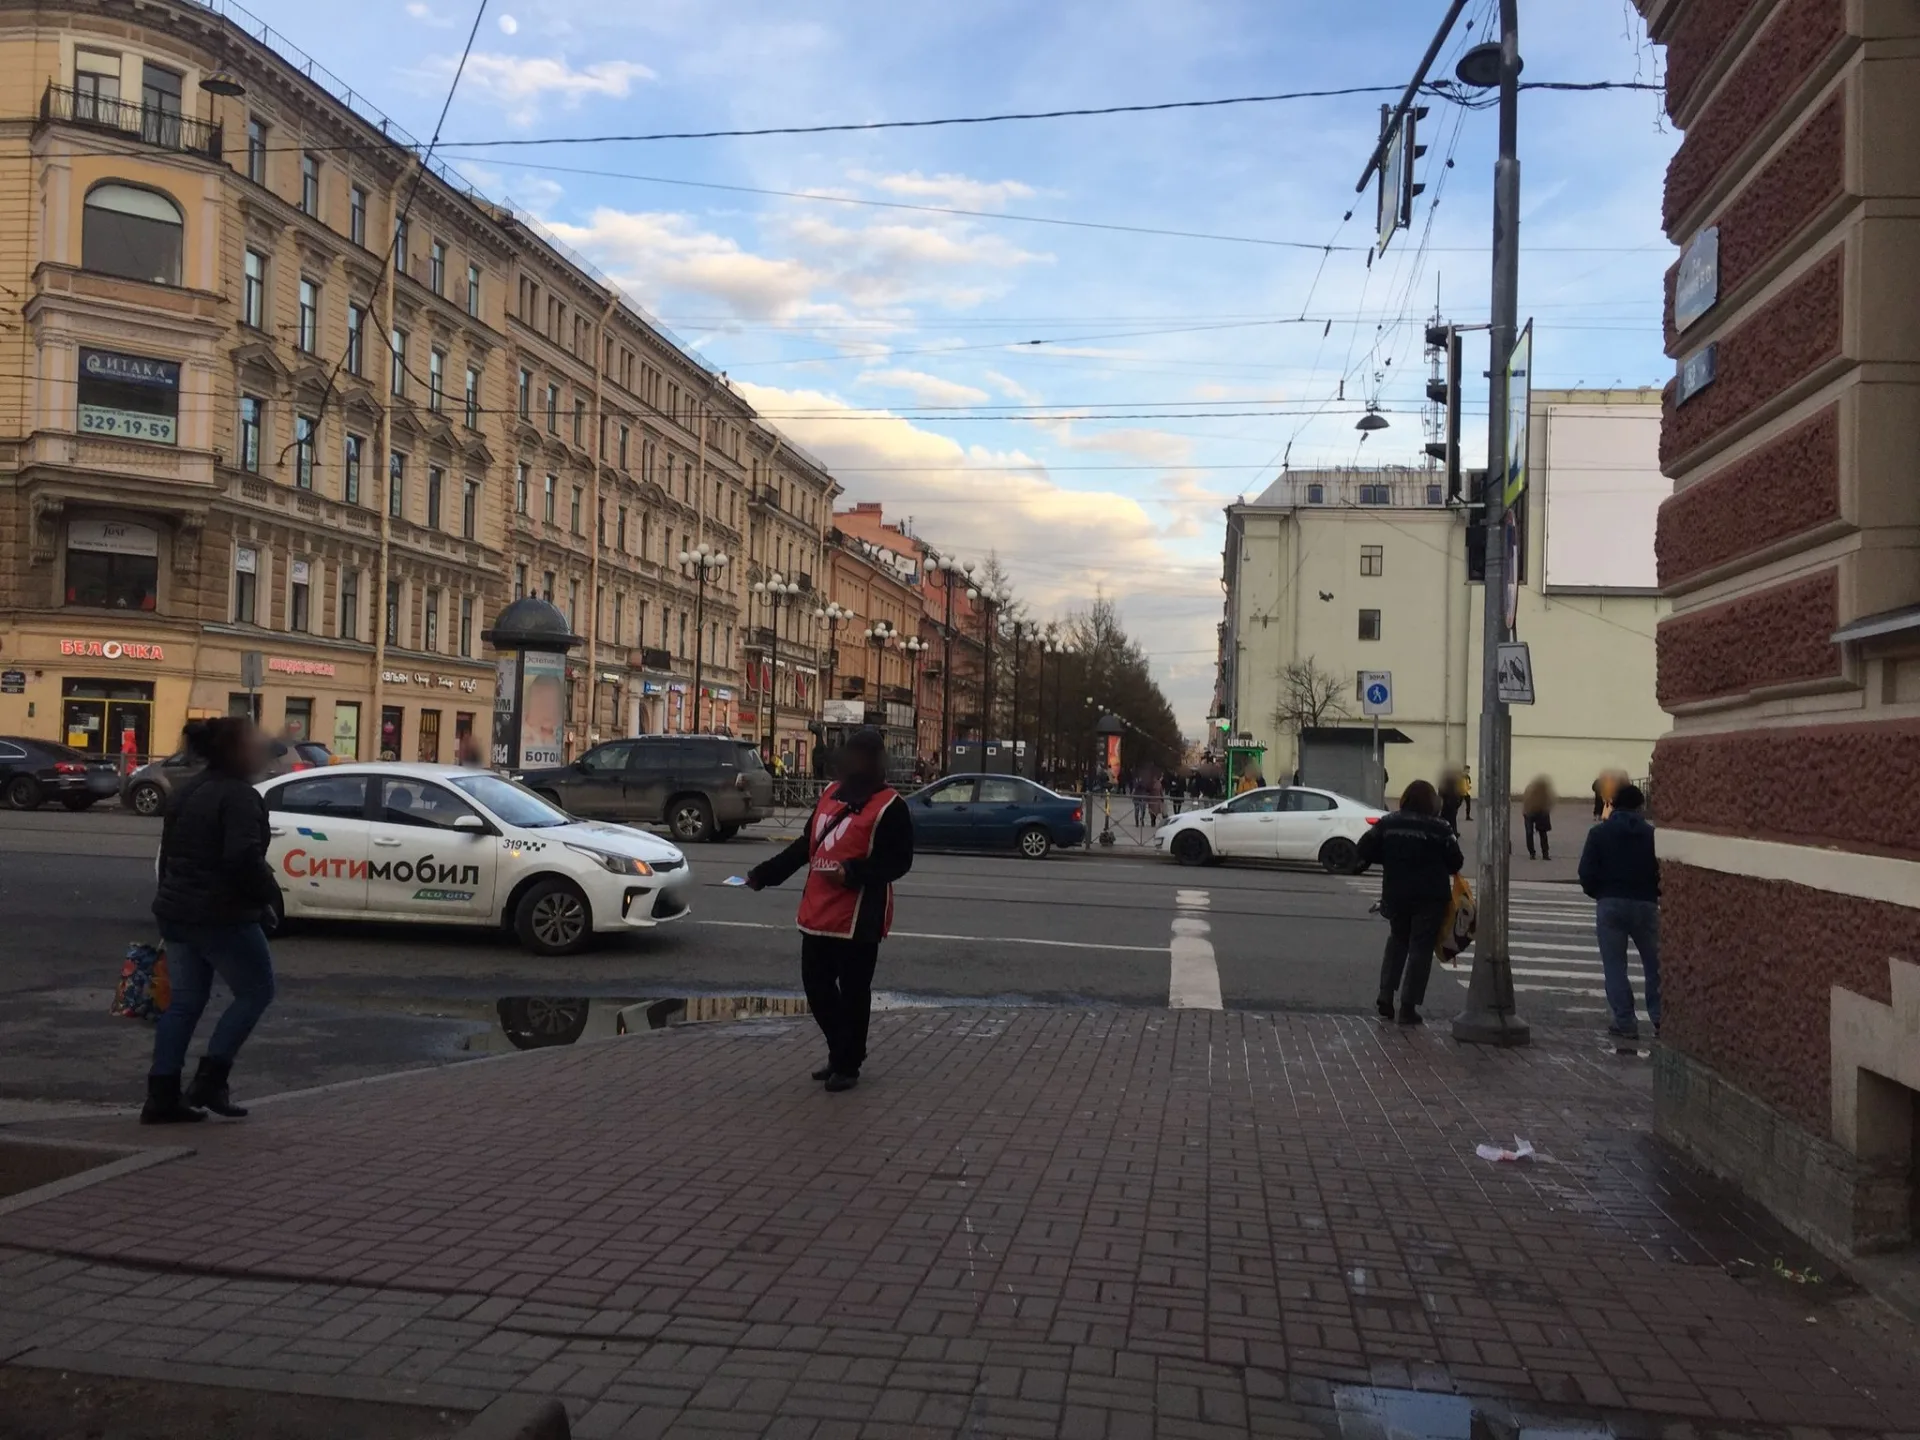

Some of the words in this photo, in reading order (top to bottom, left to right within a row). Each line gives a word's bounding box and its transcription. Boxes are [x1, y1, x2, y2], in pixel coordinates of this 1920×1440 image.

[106, 357, 166, 378] ИТАКА
[1368, 674, 1386, 682] ЗОНА
[502, 838, 522, 850] 319
[283, 848, 479, 885] Ситимобил
